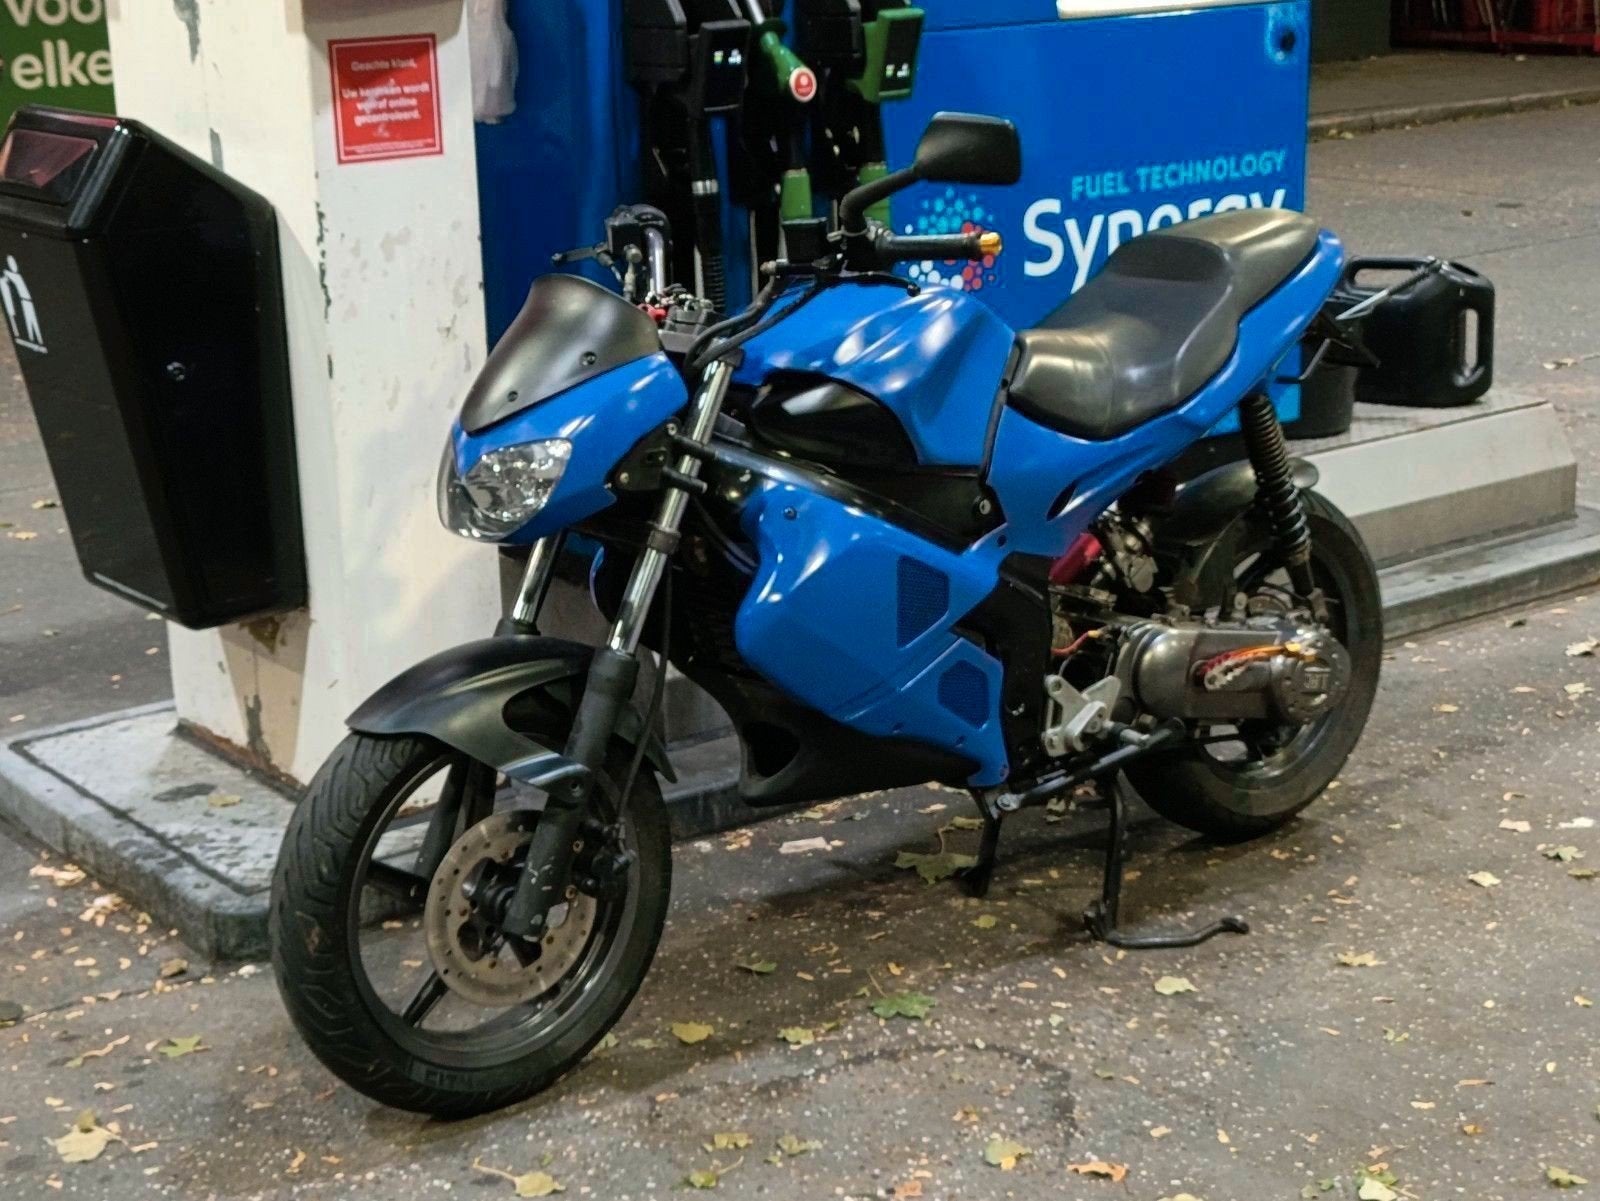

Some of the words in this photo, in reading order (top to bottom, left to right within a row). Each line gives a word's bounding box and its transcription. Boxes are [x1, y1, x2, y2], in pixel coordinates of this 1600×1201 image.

[11, 38, 113, 90] elke
[1071, 172, 1130, 200] FUEL
[1136, 152, 1286, 191] TECHNOLOGY
